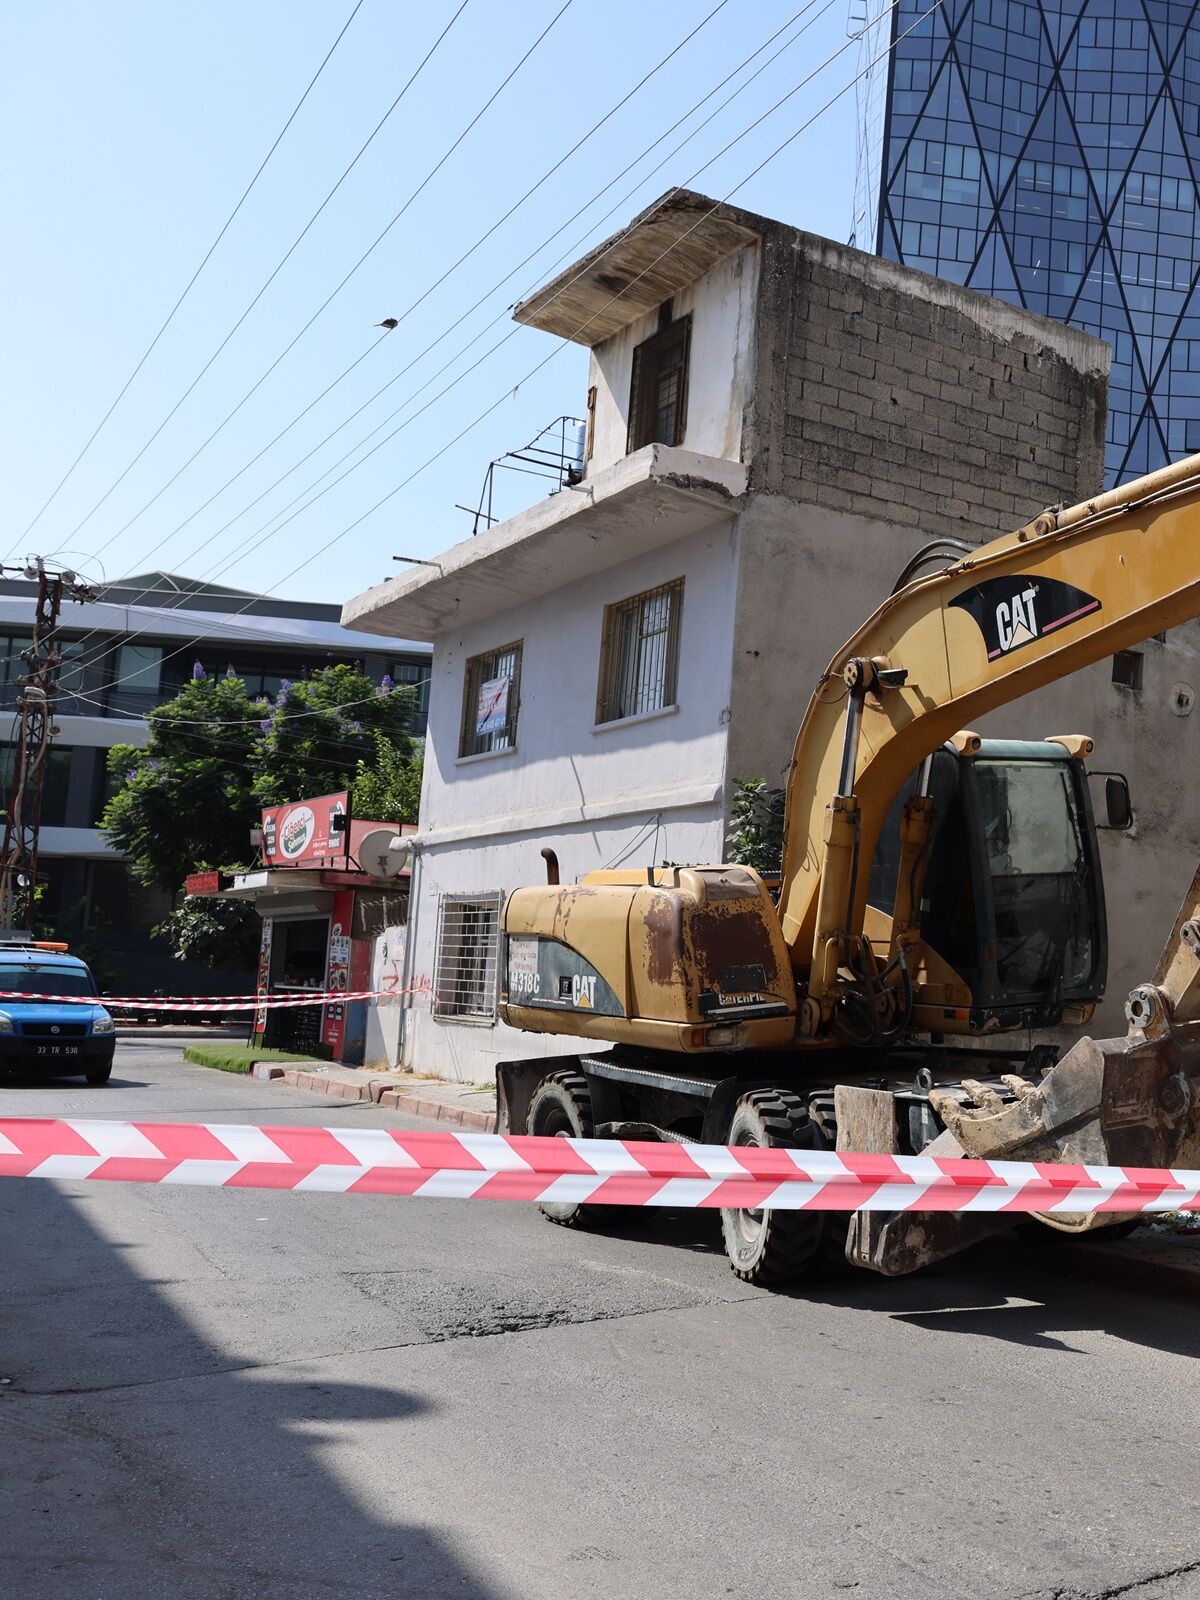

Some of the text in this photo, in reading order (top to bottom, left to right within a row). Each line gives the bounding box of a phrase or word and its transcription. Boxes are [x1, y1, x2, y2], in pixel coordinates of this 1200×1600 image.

[996, 588, 1038, 651] CAT
[510, 972, 540, 994] M318C
[572, 974, 597, 1009] CAT
[37, 1046, 46, 1054] 33
